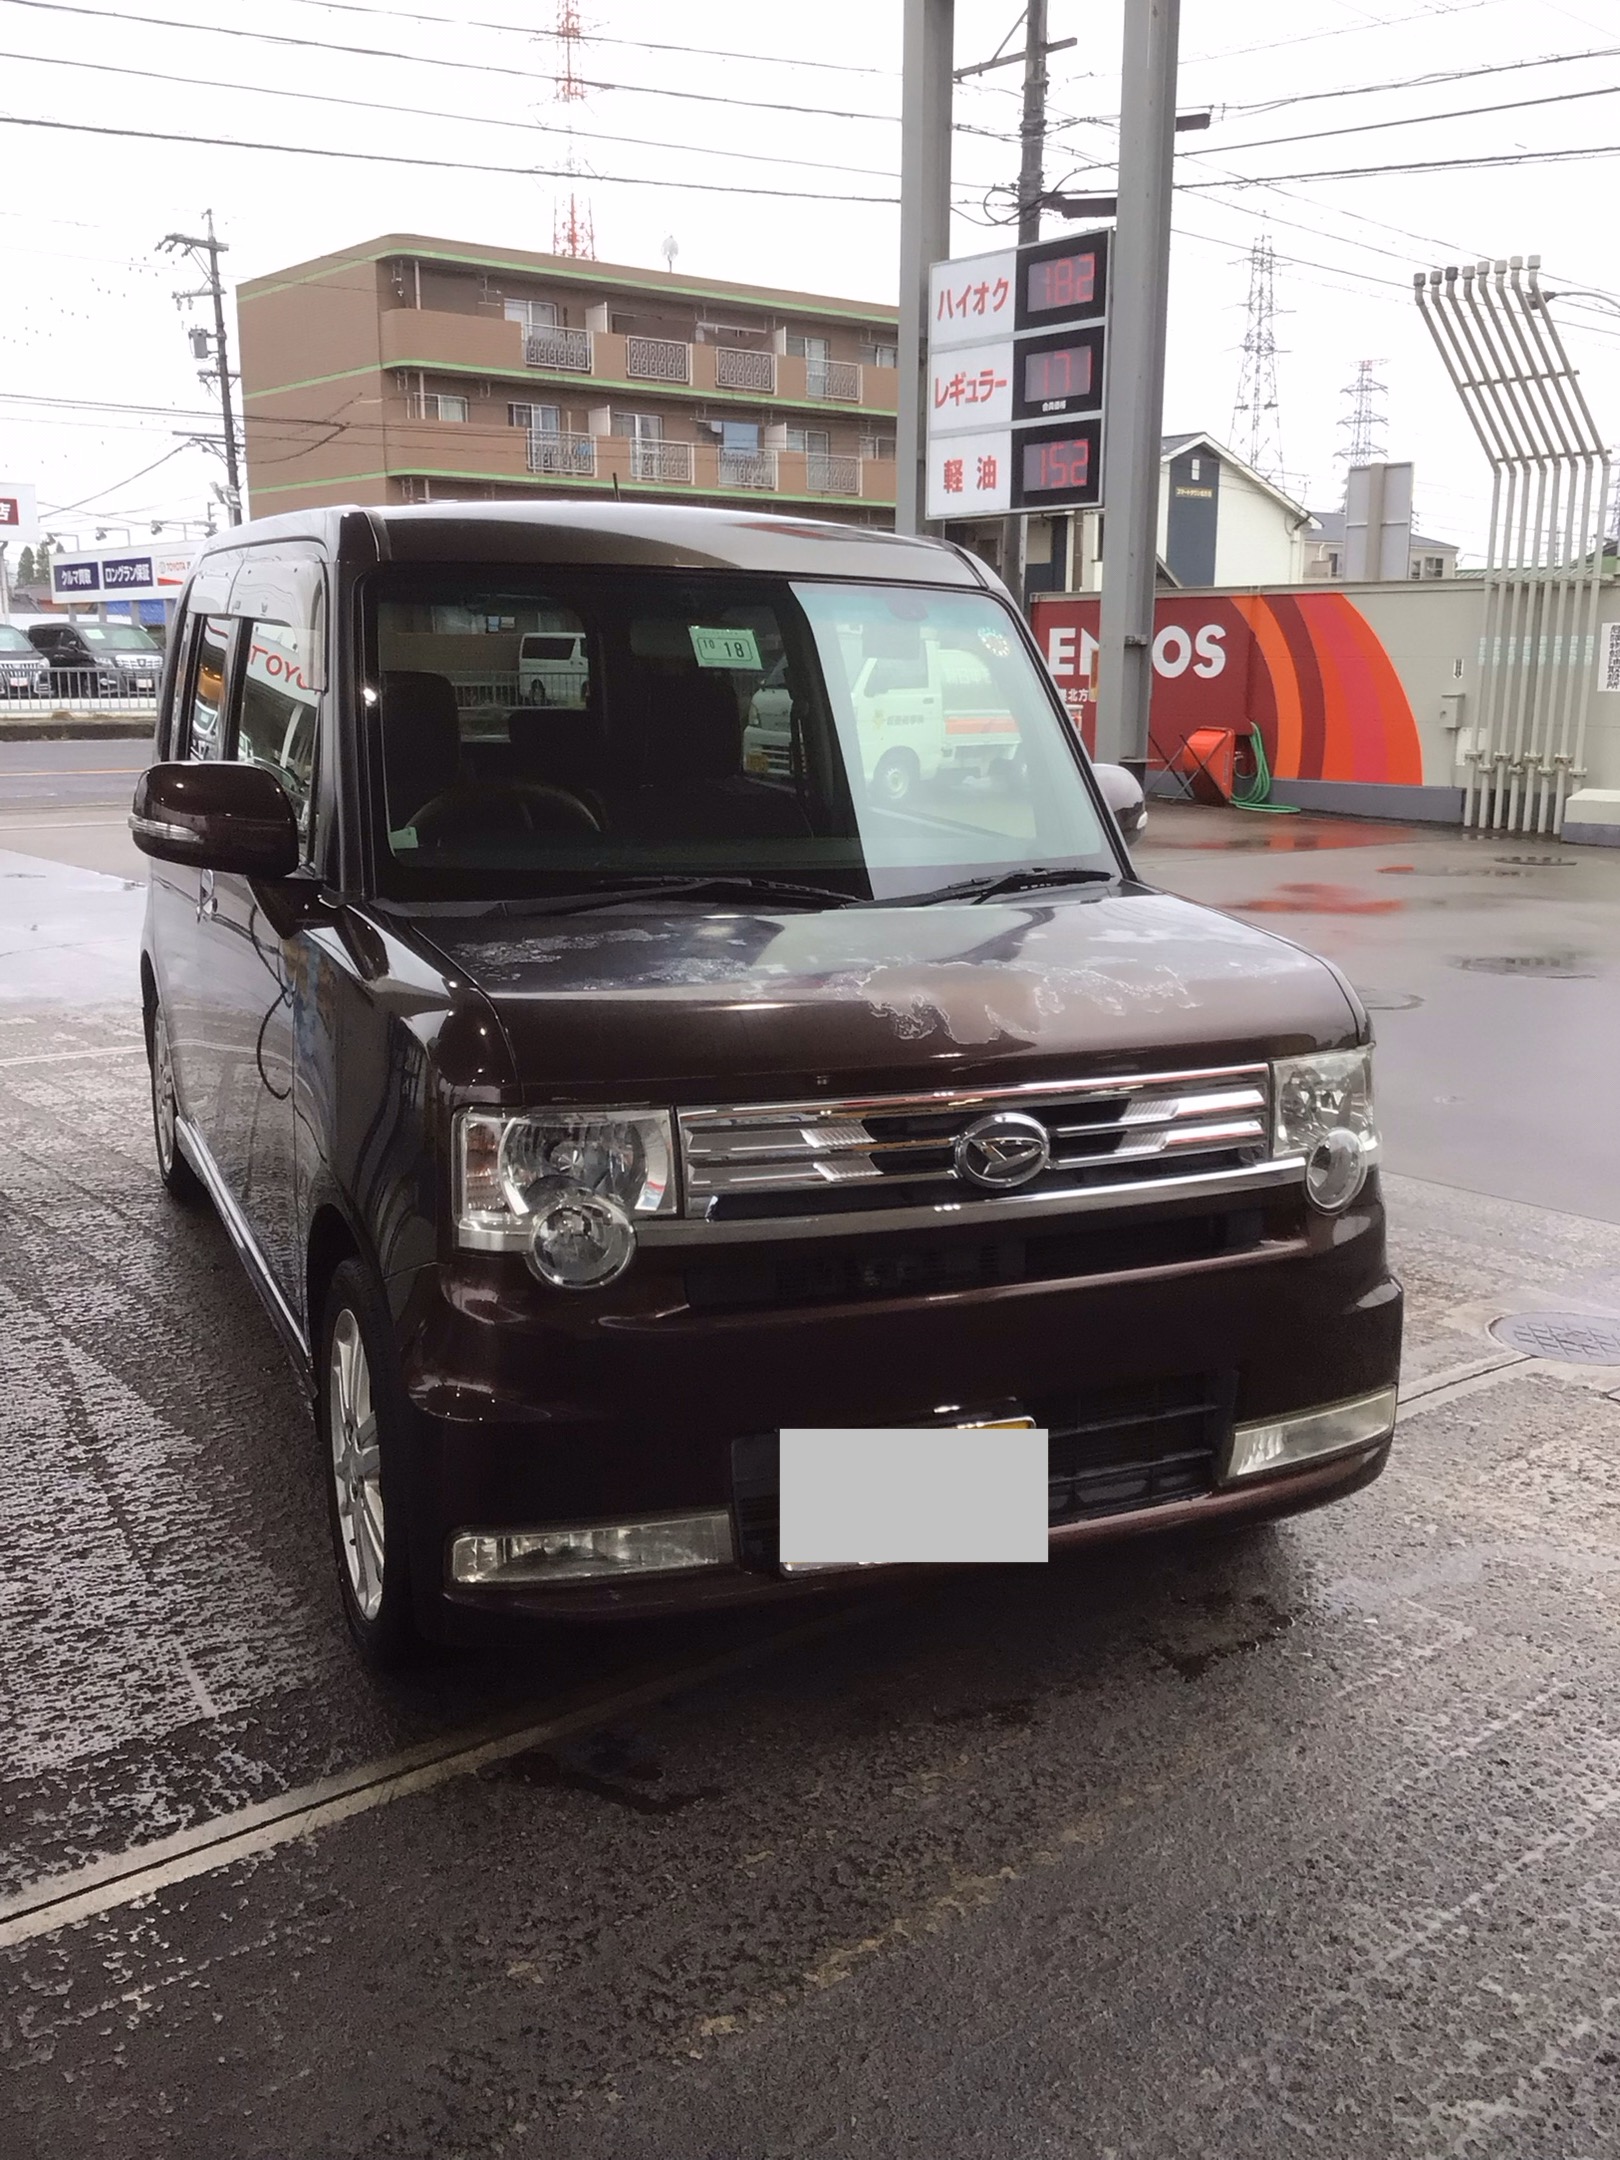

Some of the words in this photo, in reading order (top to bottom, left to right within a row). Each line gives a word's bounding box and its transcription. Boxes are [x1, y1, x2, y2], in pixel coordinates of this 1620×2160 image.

[937, 278, 1009, 321] ハイオク
[935, 369, 1007, 409] レギュラー
[1040, 440, 1090, 486] 152
[724, 641, 744, 658] 18
